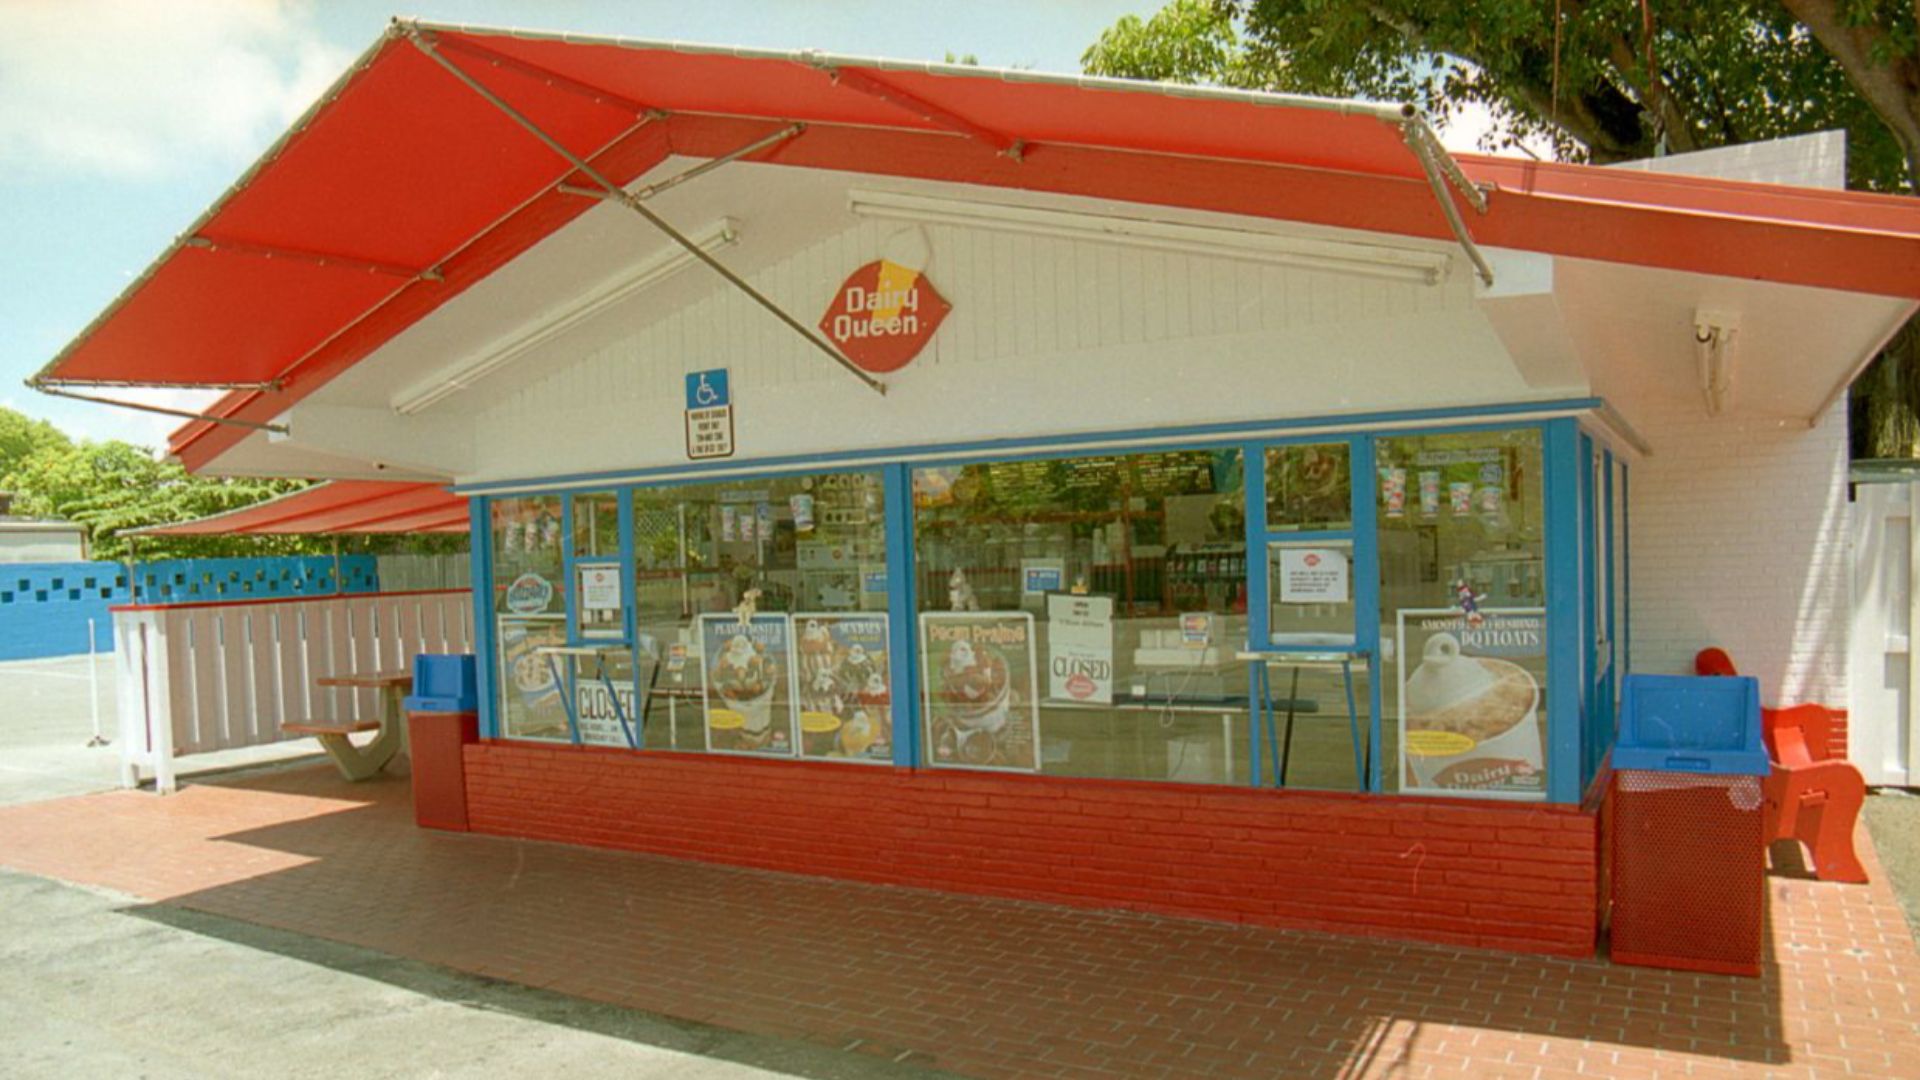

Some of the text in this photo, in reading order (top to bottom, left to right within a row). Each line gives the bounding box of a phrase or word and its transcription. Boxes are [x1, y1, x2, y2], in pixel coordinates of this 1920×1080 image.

[846, 279, 918, 312] Dairy
[834, 313, 918, 342] Queen
[1053, 656, 1110, 681] CLOSED
